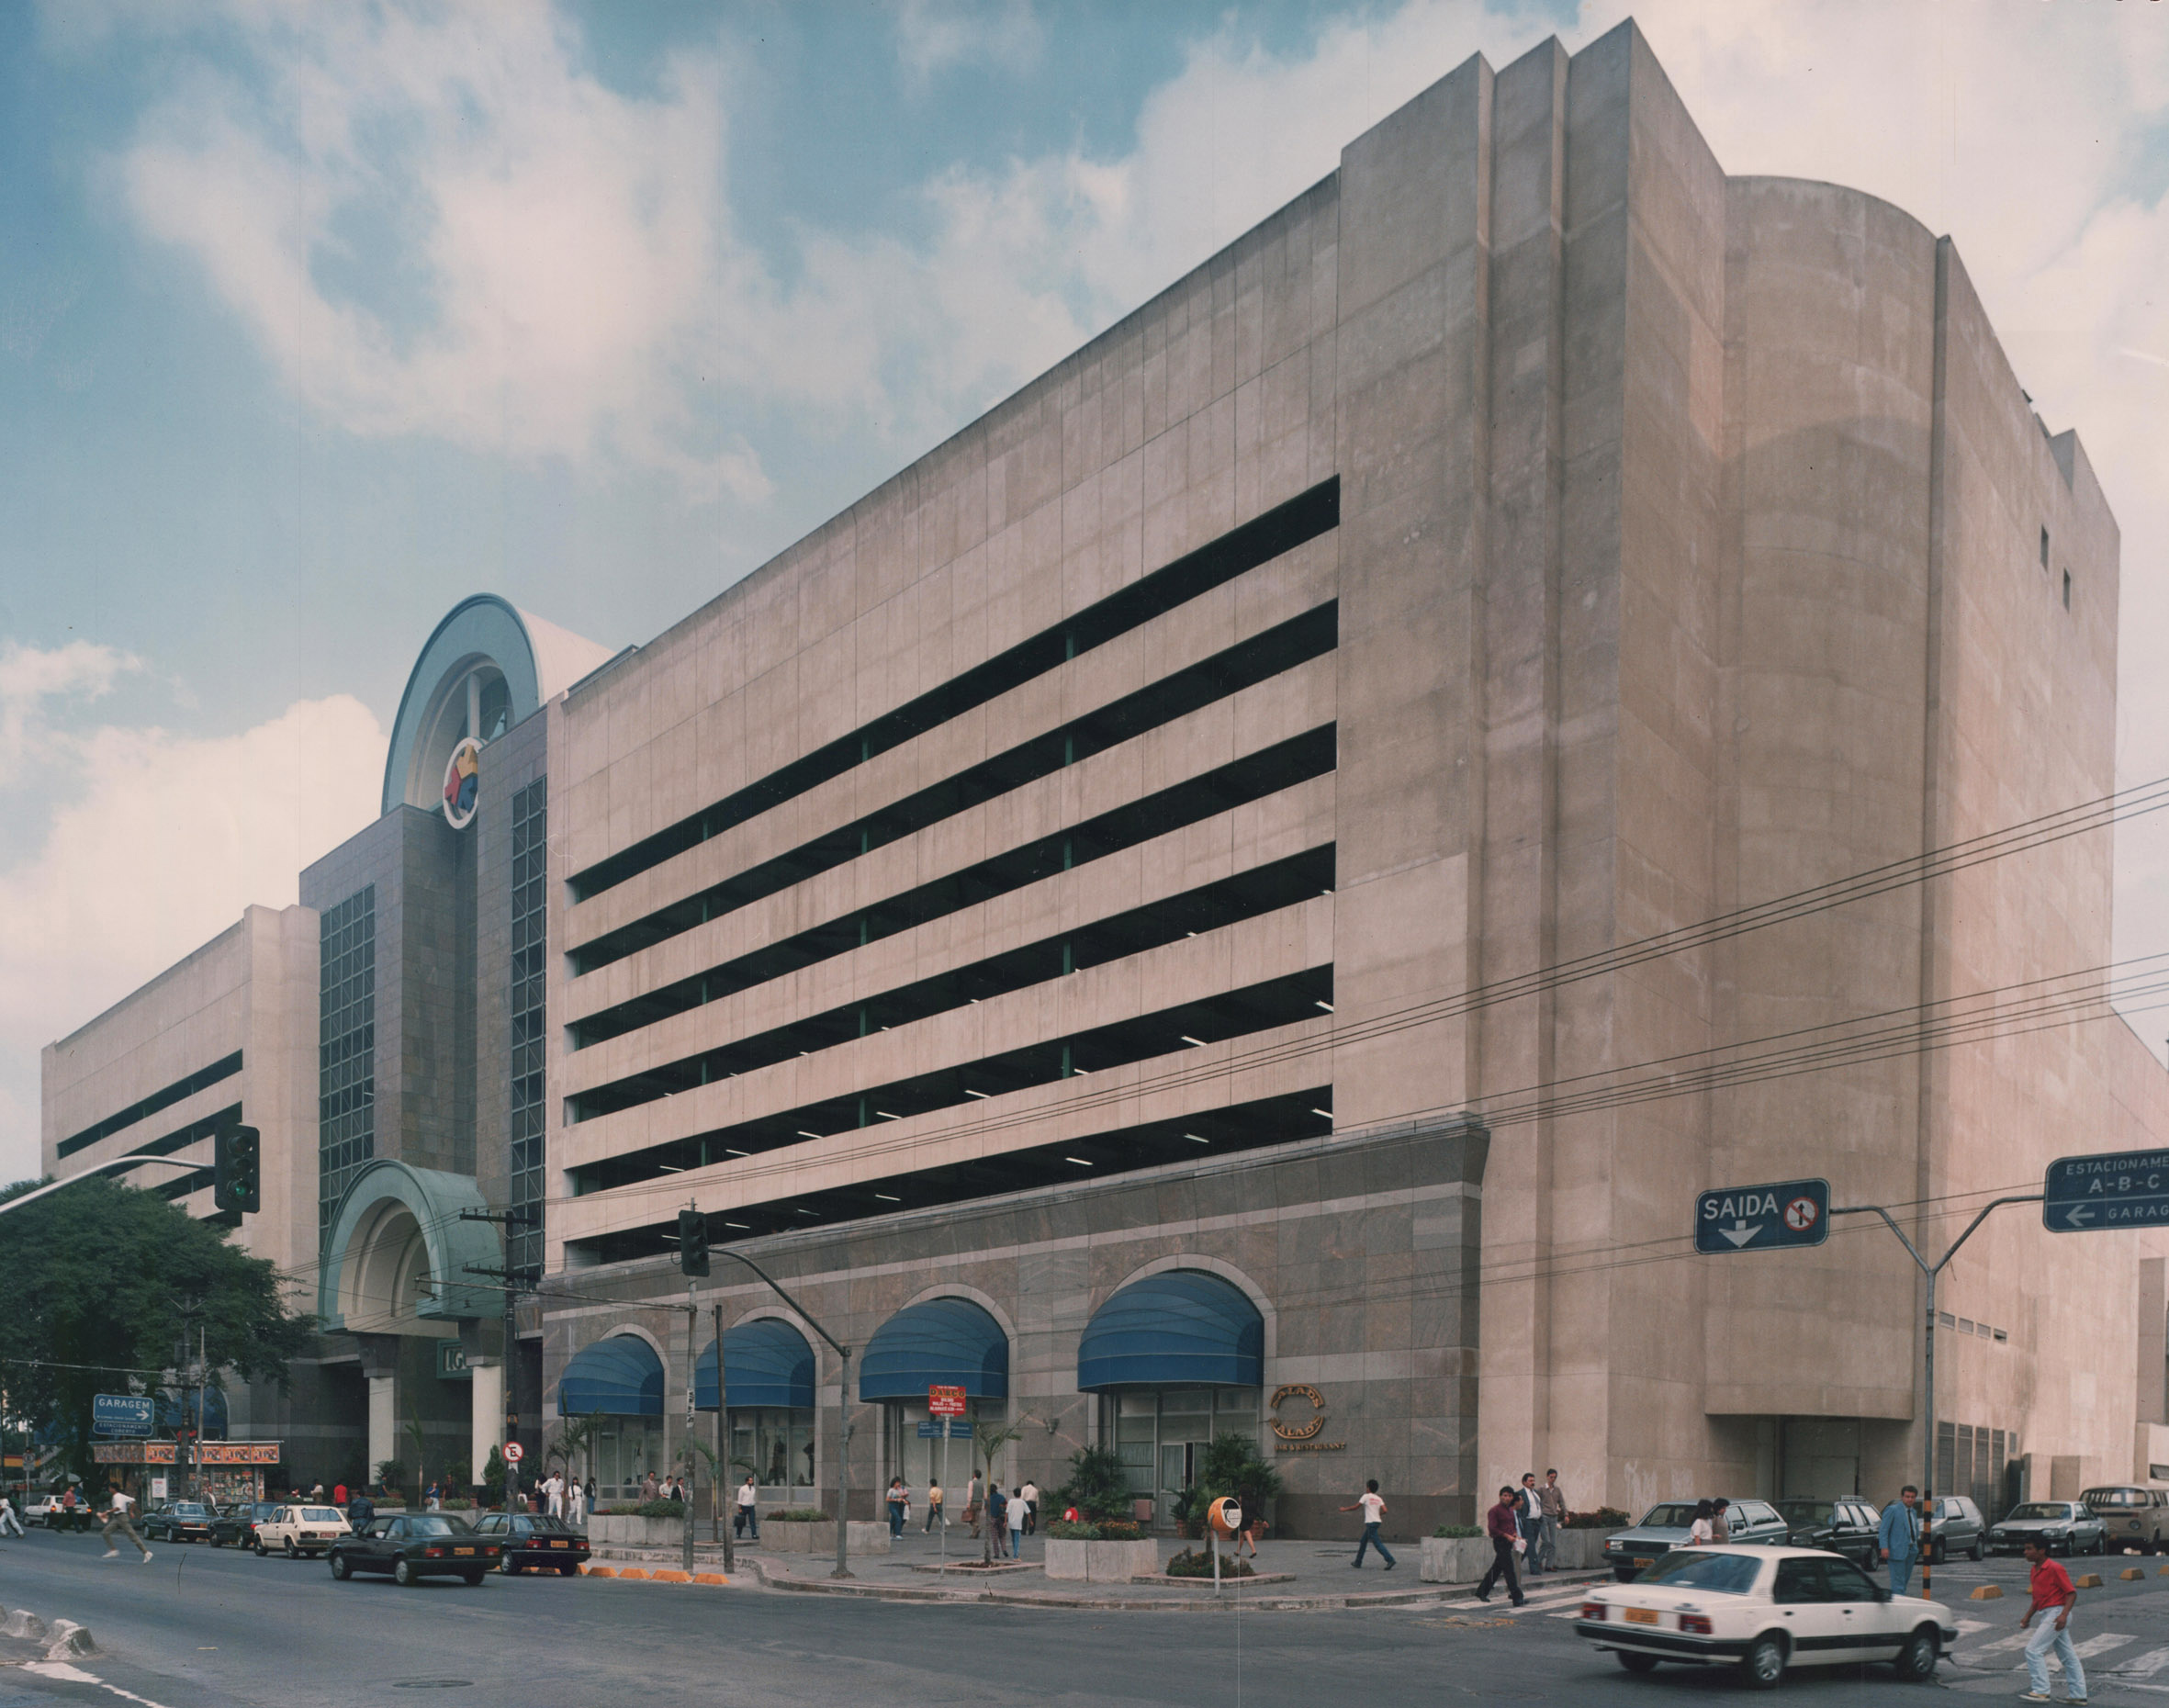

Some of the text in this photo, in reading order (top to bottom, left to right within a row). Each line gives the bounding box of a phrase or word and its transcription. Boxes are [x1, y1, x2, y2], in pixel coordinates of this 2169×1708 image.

[2066, 1156, 2169, 1175] ESTACIONAME
[1703, 1192, 1779, 1219] SAIDA
[2108, 1204, 2169, 1219] GARAG
[929, 1388, 965, 1399] DARCO
[98, 1398, 150, 1410] GARAGEM
